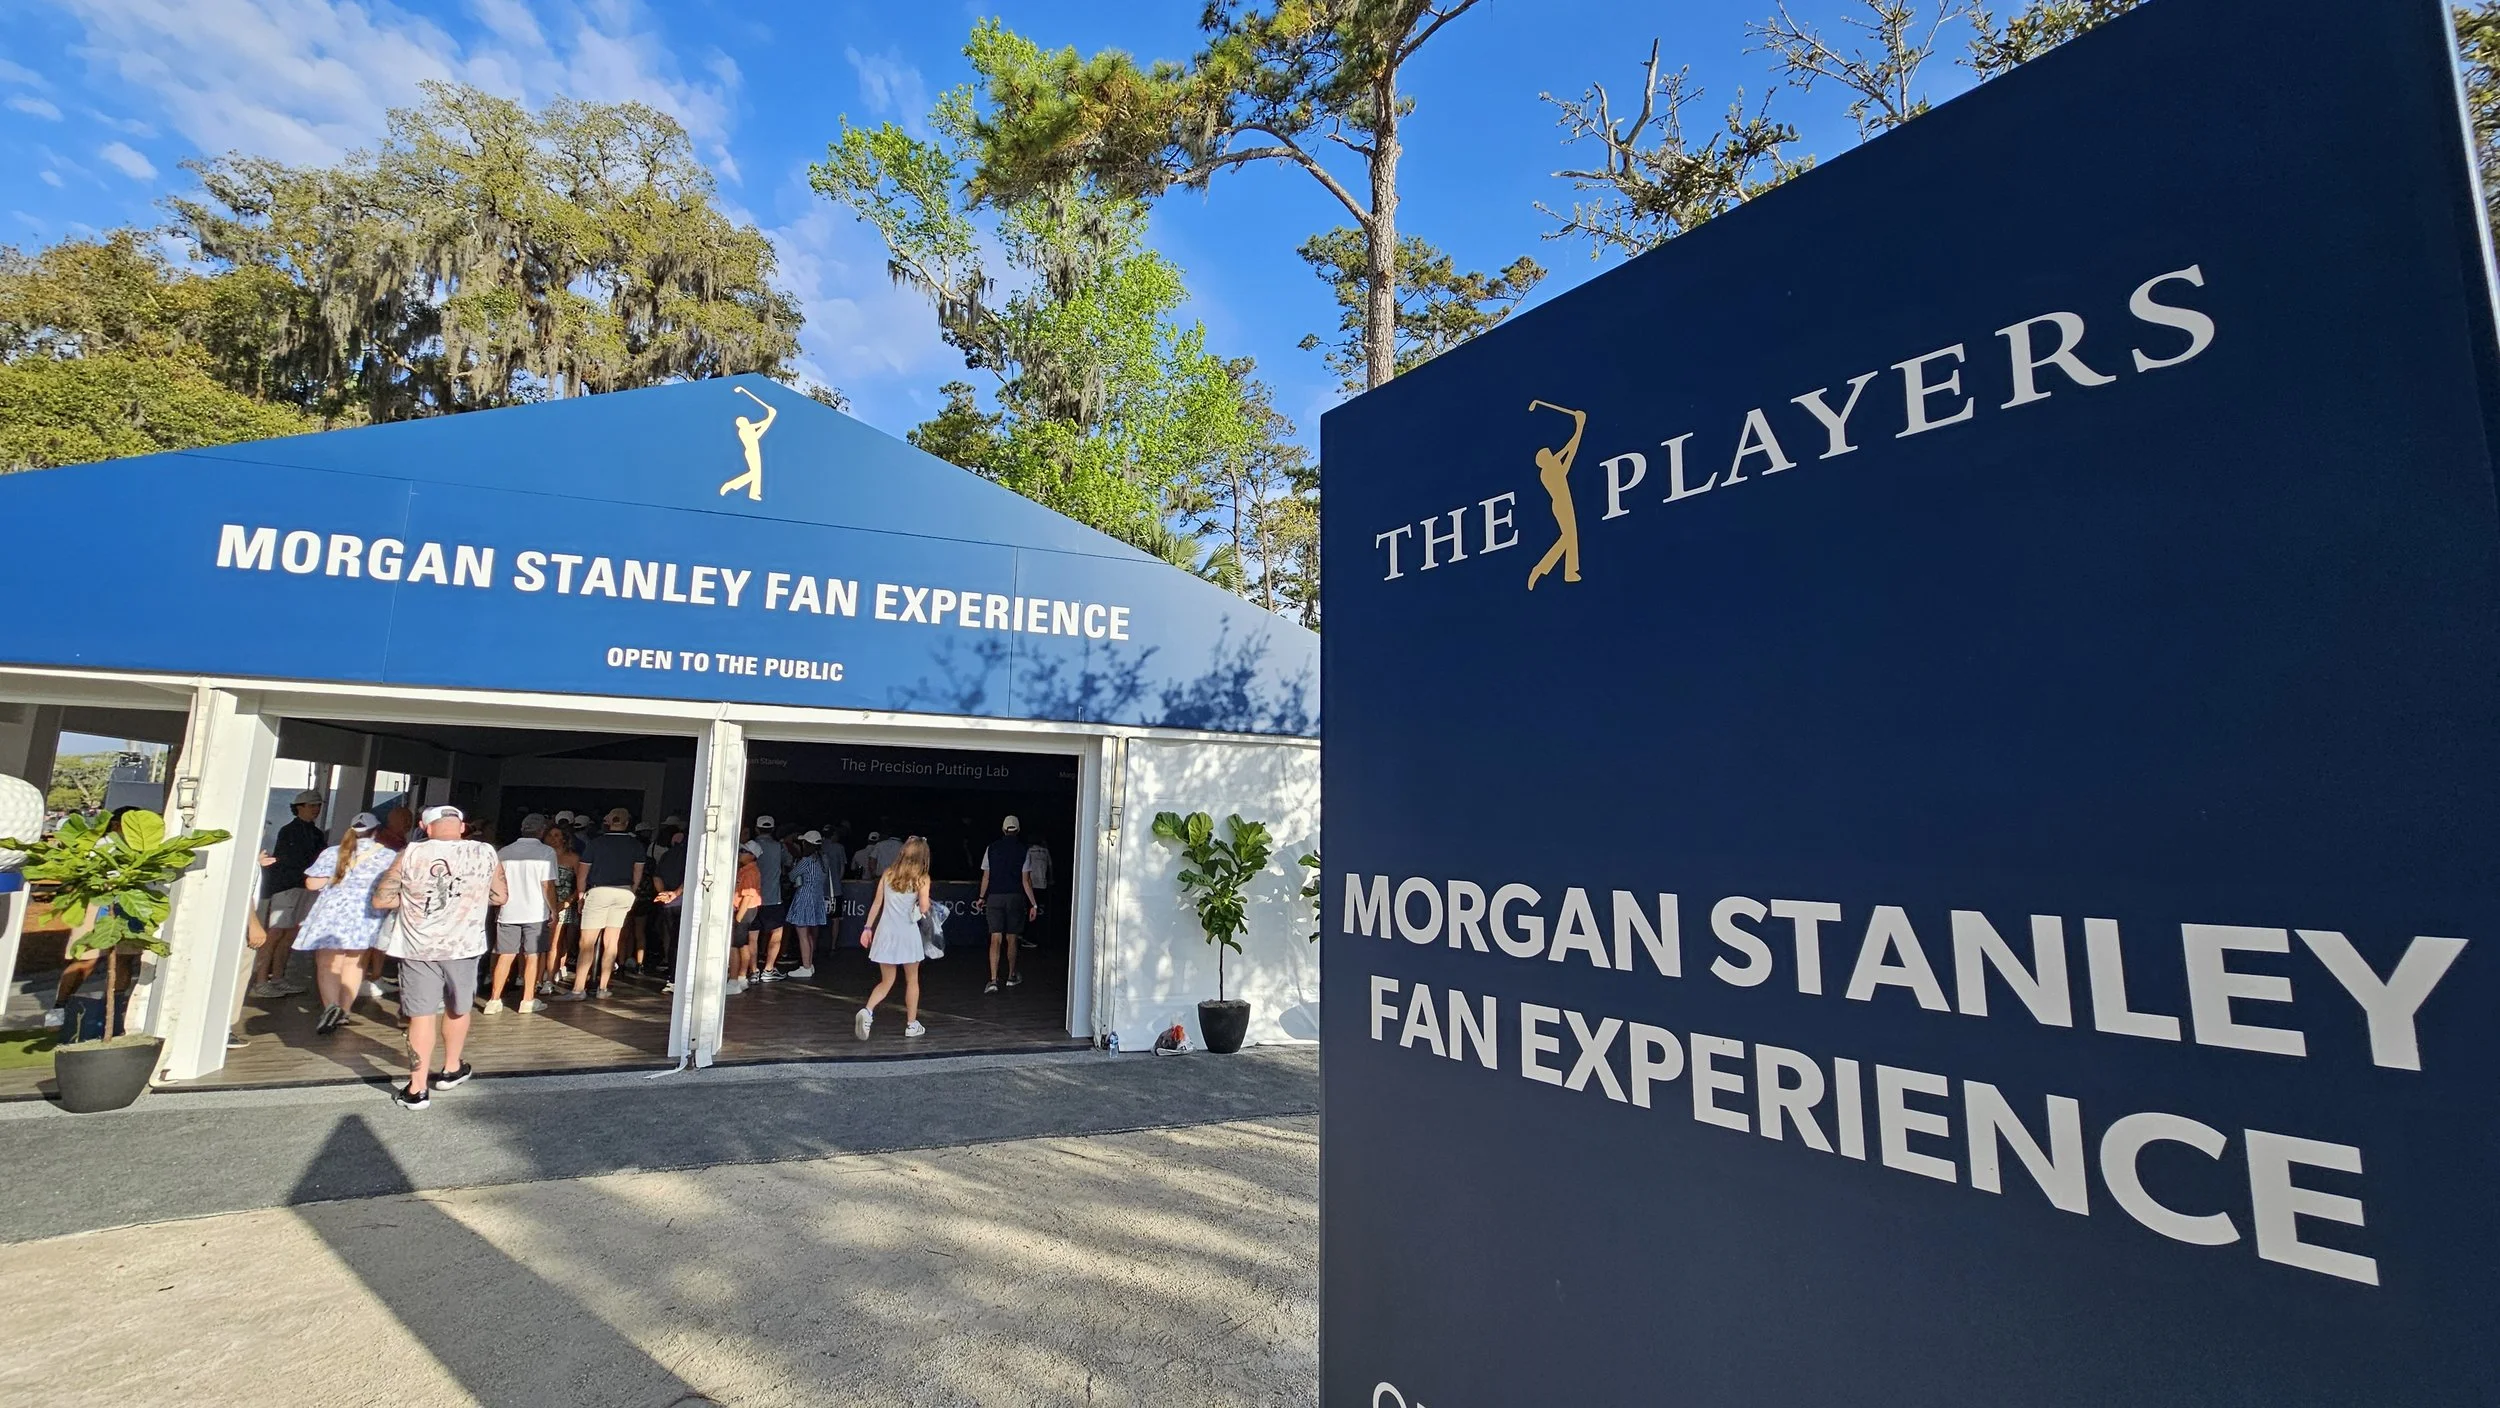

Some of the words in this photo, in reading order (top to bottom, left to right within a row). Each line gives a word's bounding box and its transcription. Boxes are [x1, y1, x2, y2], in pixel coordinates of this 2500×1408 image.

[1376, 491, 1519, 581] THE
[1600, 264, 2215, 521] PLAYERS
[217, 525, 495, 587] MORGAN
[514, 551, 751, 607] STANLEY
[766, 572, 858, 616] FAN
[875, 583, 1130, 641] EXPERIENCE
[608, 647, 673, 670] OPEN
[680, 651, 710, 672] TO
[716, 654, 759, 676] THE
[765, 658, 844, 682] PUBLIC
[840, 757, 867, 772] The
[870, 759, 932, 775] Precision
[936, 762, 983, 779] Putting
[986, 764, 1009, 778] Lab
[1344, 873, 1682, 978] MORGAN
[1710, 895, 2469, 1072] STANLEY
[1371, 974, 1498, 1071] FAN
[1520, 1001, 2380, 1288] EXPERIENCE
